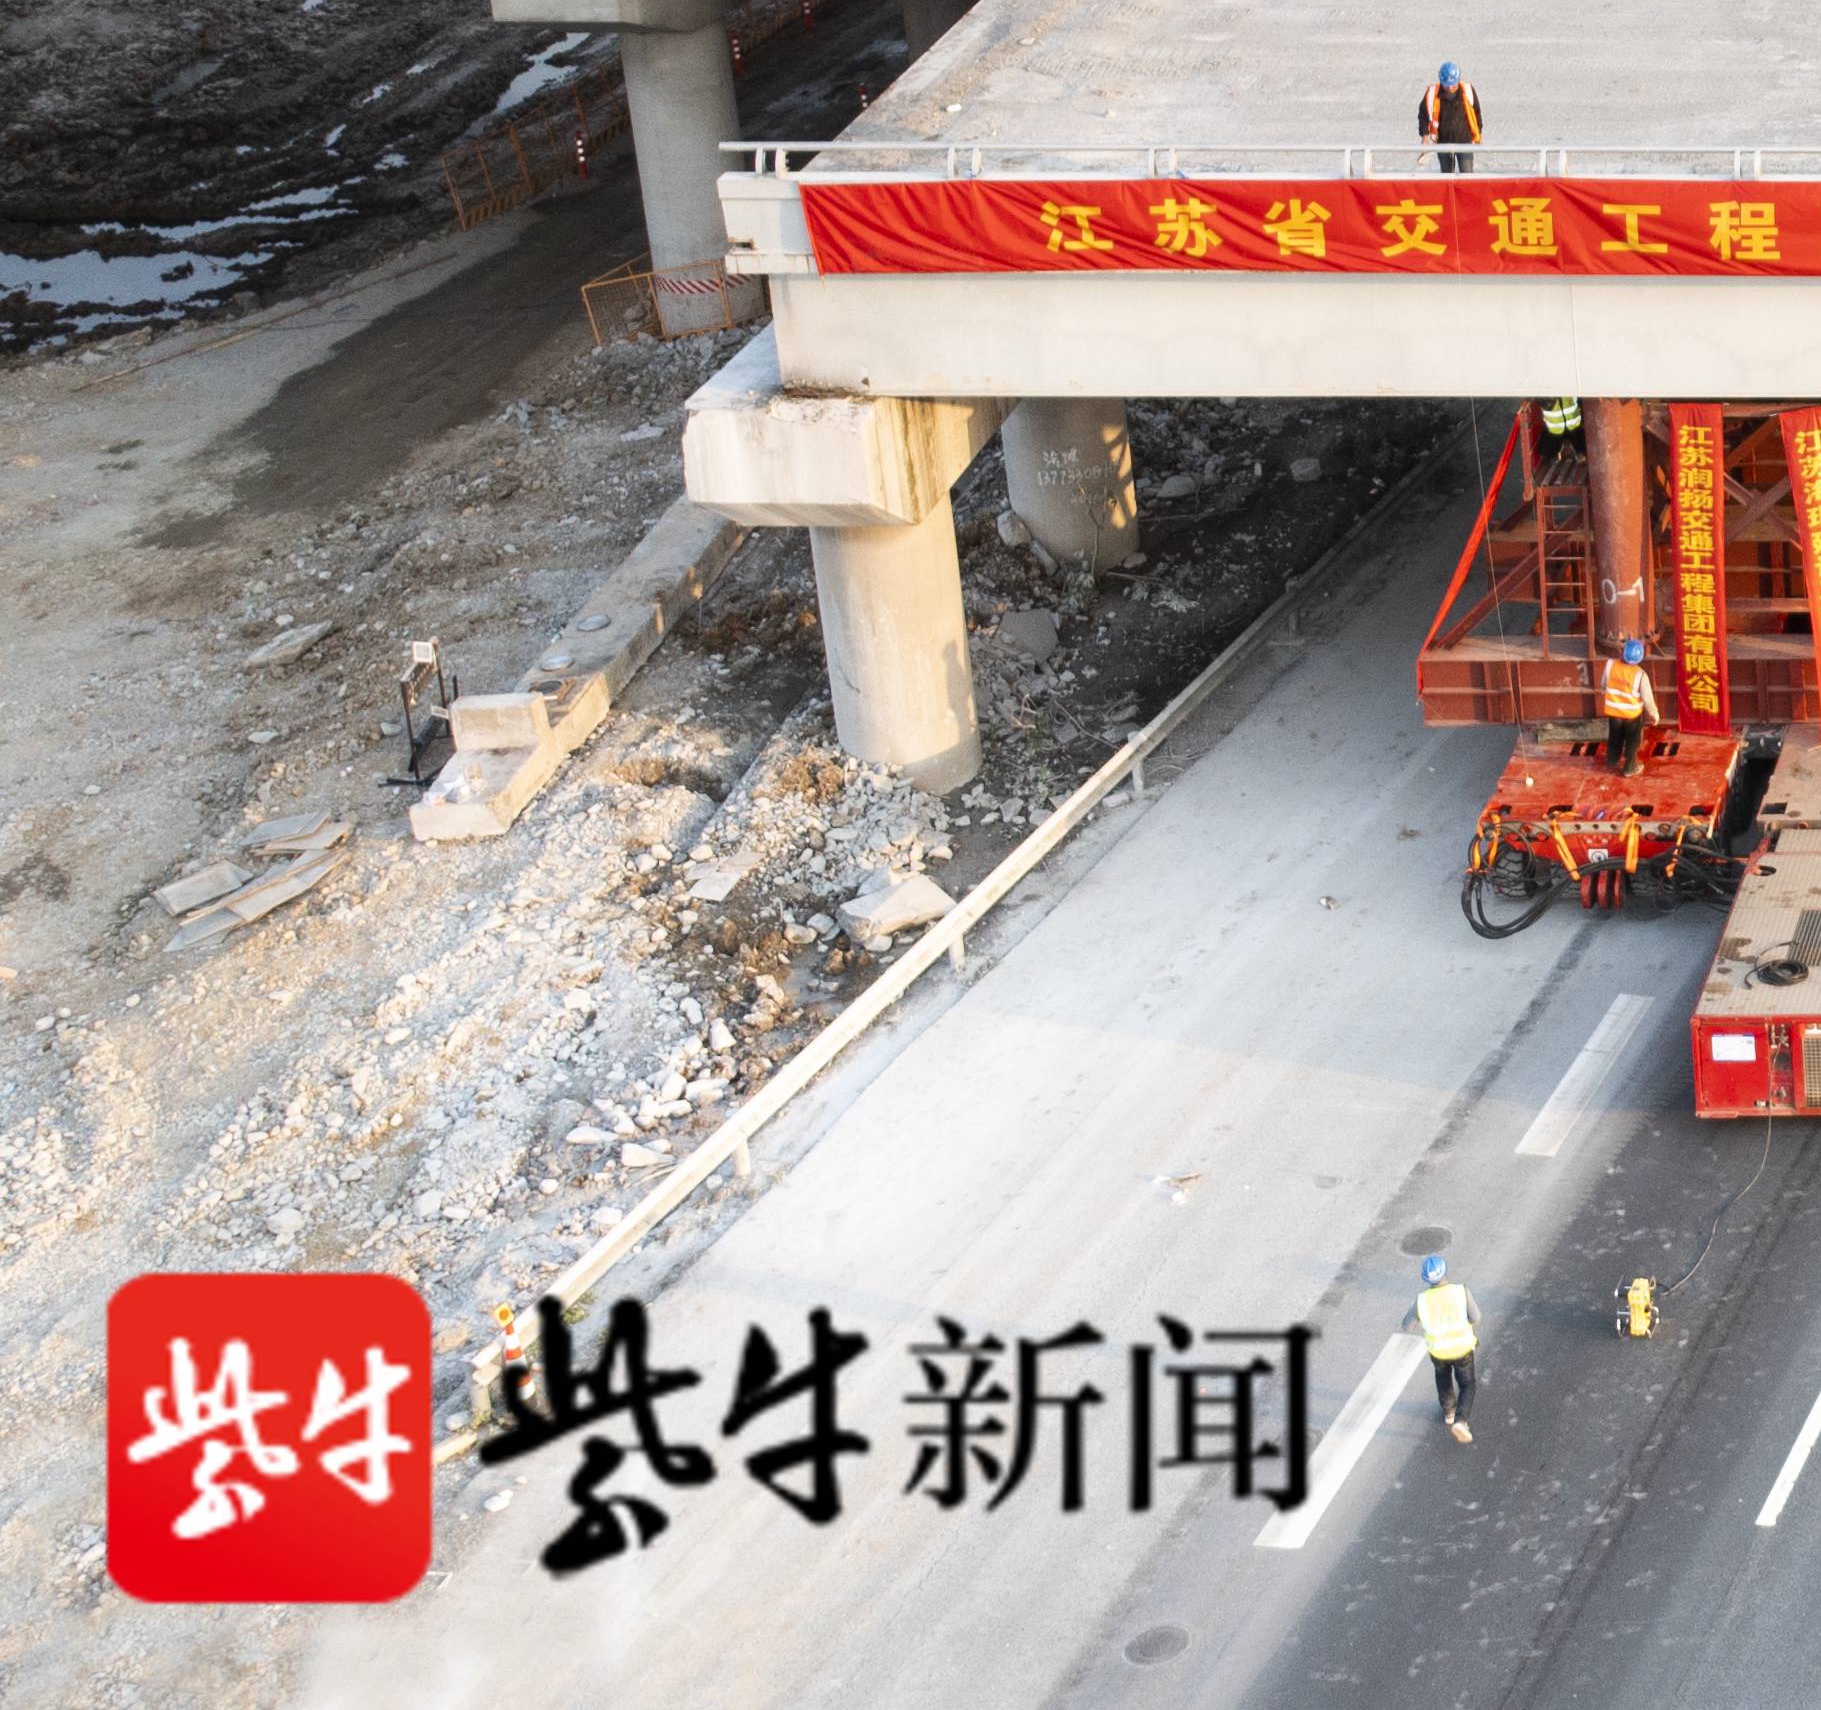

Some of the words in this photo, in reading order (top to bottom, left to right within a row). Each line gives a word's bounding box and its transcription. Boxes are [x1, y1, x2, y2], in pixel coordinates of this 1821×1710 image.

[1678, 424, 1720, 715] 江苏润扬交通工程集团有限公司
